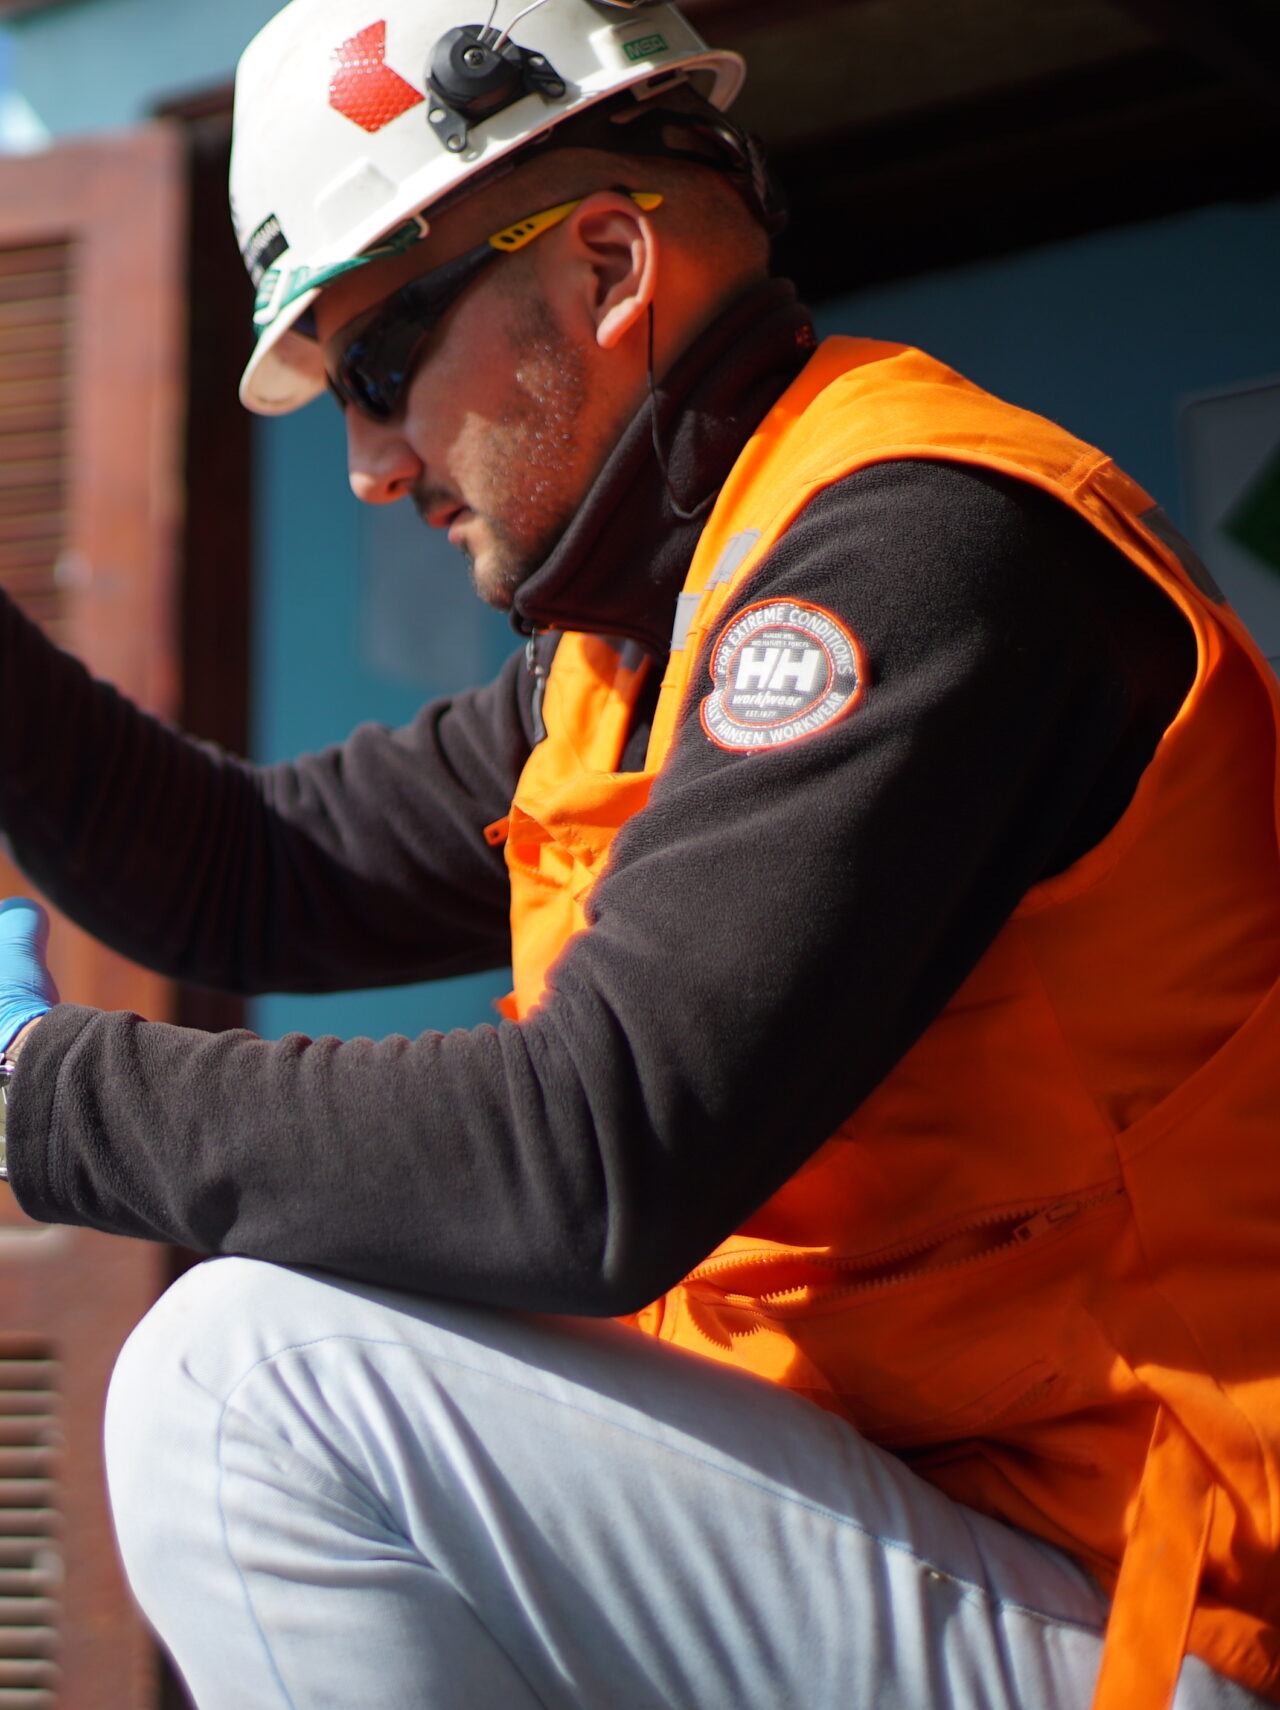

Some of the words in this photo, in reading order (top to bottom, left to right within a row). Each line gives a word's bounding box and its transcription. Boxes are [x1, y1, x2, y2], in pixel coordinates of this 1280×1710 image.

[626, 36, 666, 59] MSA
[716, 645, 733, 675] FOR
[730, 606, 786, 646] EXTREME
[789, 607, 853, 676] CONDITIONS
[734, 647, 823, 692] HH
[716, 720, 765, 745] HANSEN
[770, 691, 847, 745] WORKWEAR
